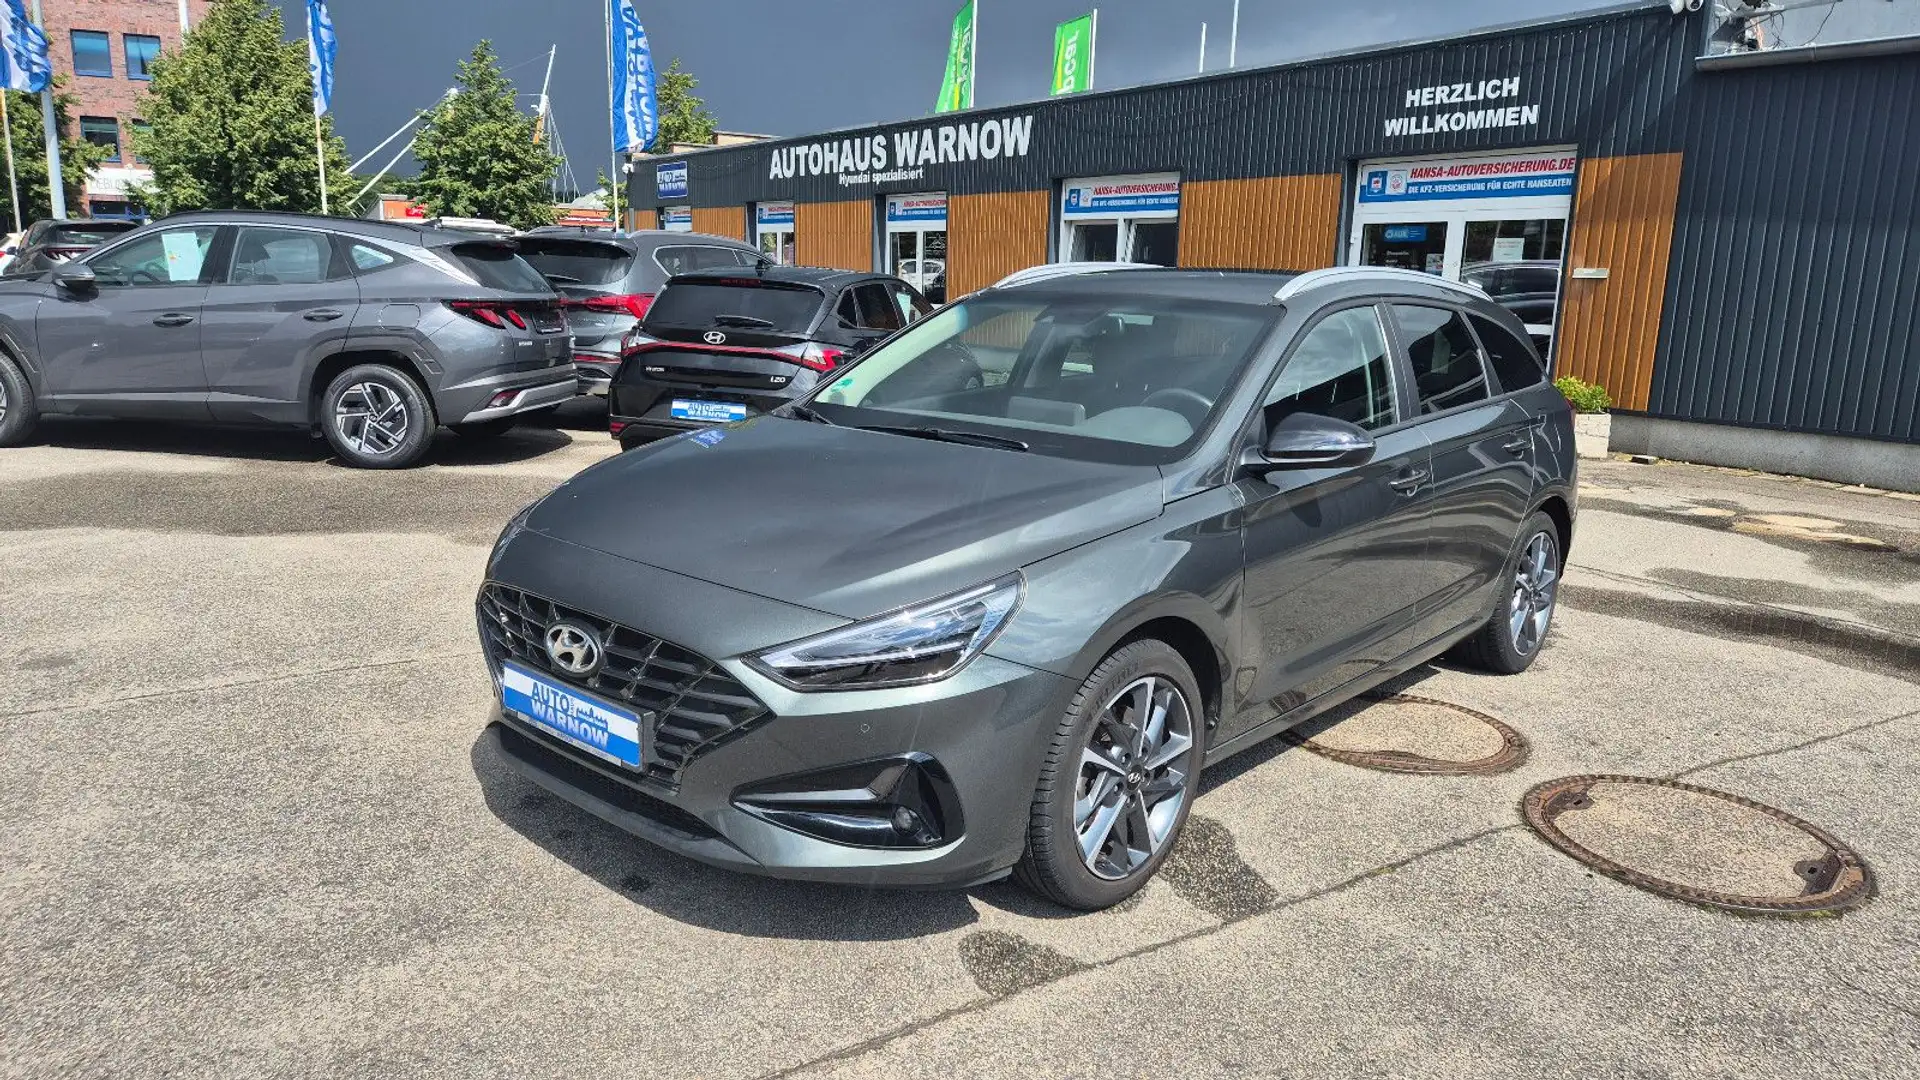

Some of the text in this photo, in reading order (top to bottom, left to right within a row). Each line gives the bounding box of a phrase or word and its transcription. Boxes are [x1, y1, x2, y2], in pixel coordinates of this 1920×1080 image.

[1405, 76, 1520, 108] HERZLICH
[1384, 104, 1539, 137] WILLKOMMEN
[769, 115, 1034, 180] AUTOHAUS WARNOW
[838, 167, 923, 187] Hyundai spezialisiert
[1410, 157, 1576, 179] HANSA-AUTOVERSICHERUNG.DE
[1408, 178, 1572, 194] DIE KFZ-VERSICHERUNG FÜR ECHTE HANSEATEN
[688, 402, 711, 411] AUTO
[688, 409, 730, 418] WARNOW
[531, 681, 570, 712] AUTO
[531, 699, 609, 748] WARNOW
